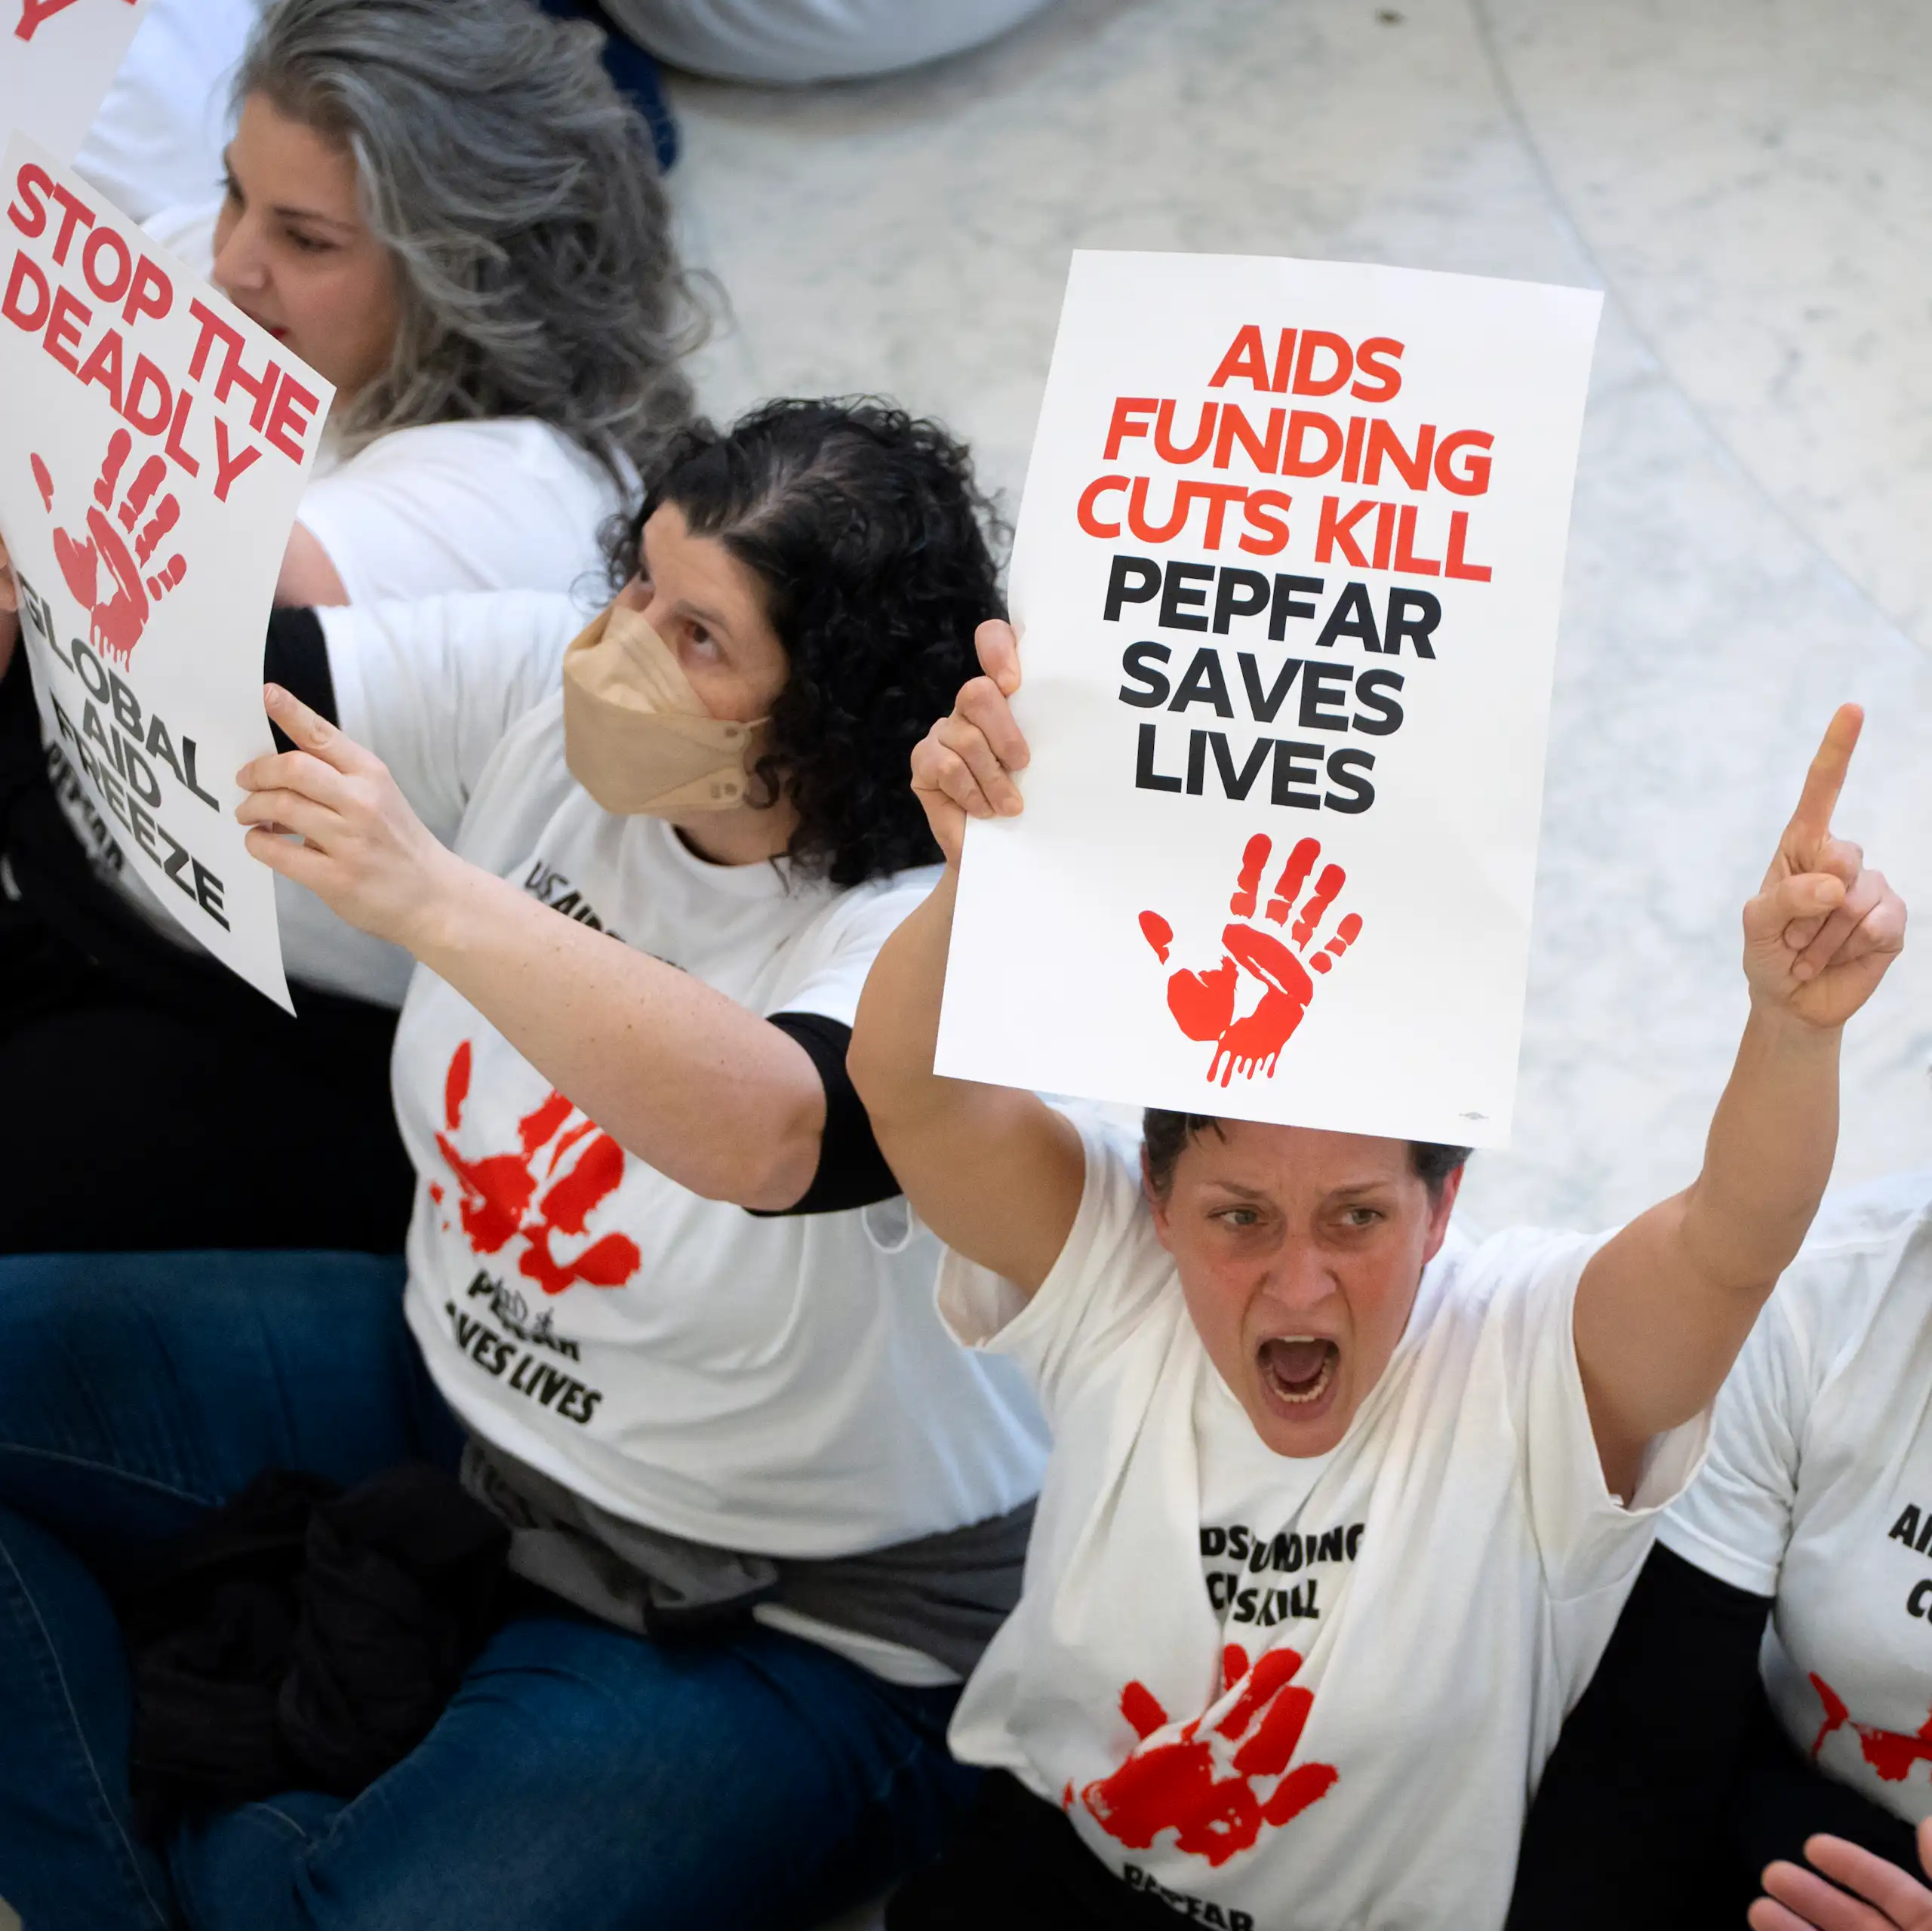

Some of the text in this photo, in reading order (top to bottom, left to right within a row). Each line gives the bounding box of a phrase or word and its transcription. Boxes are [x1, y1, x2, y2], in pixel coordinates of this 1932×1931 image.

[8, 164, 318, 466] STOP THE
[1208, 325, 1404, 403] AIDS
[2, 250, 261, 503] DEADLY
[1103, 398, 1494, 496] FUNDING
[1078, 475, 1491, 583] CUTS KILL
[1103, 555, 1441, 659] PEPFAR
[16, 570, 220, 813] GLOBAL
[1119, 641, 1404, 736] SAVES
[83, 698, 162, 808] AID
[1136, 724, 1375, 814] LIVES
[49, 687, 230, 933] FREEZE
[445, 1299, 517, 1376] VES
[509, 1355, 603, 1424] LIVES
[1256, 1579, 1319, 1627] KILL
